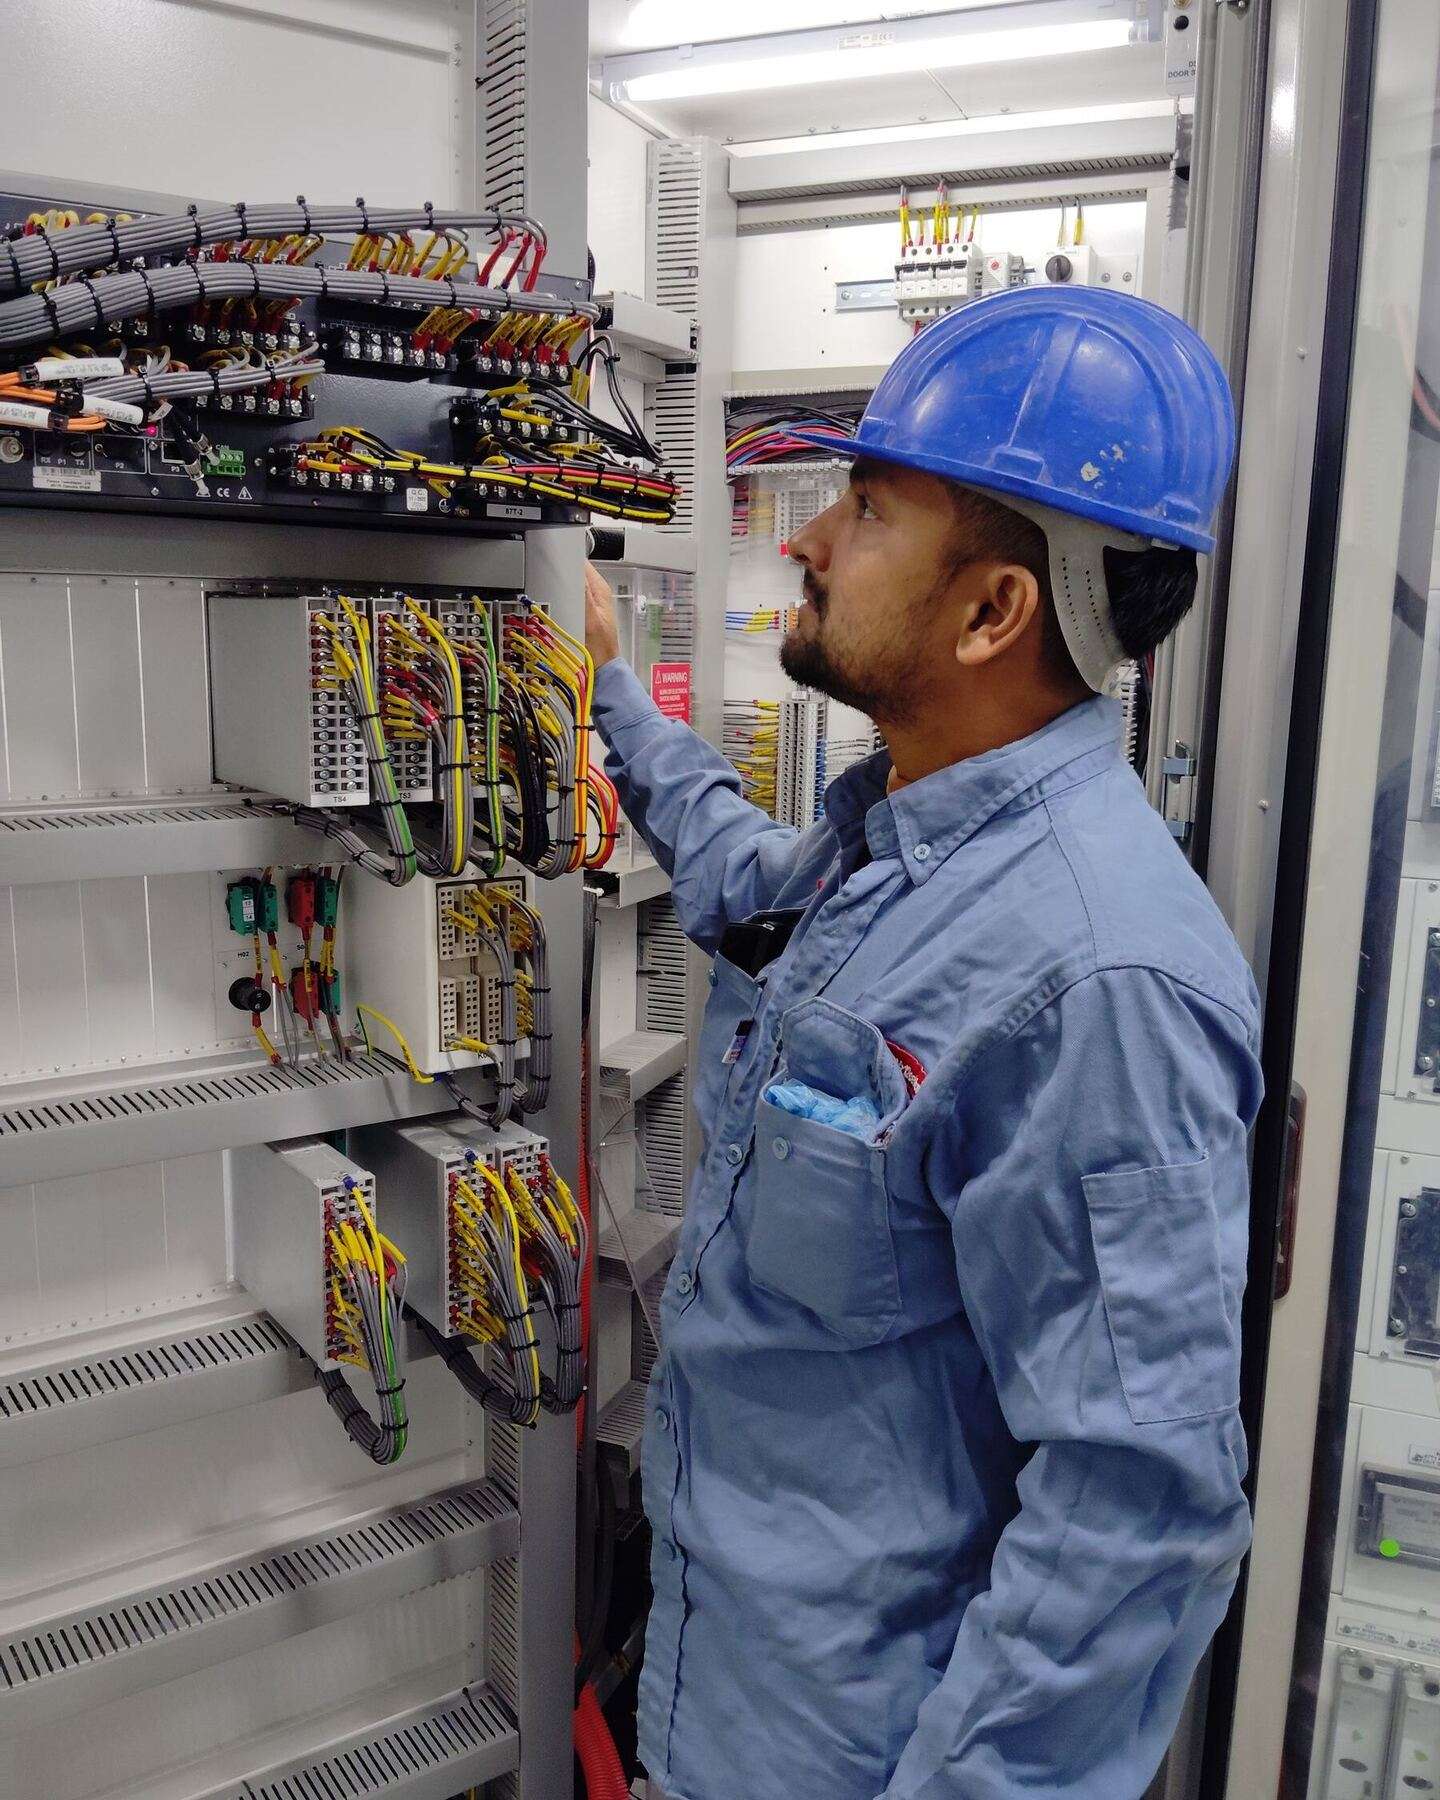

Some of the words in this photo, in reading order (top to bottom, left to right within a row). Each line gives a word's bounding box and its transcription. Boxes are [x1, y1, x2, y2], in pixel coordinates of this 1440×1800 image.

[1168, 70, 1189, 78] DOOR
[216, 488, 230, 497] CE
[662, 672, 688, 683] WARNING
